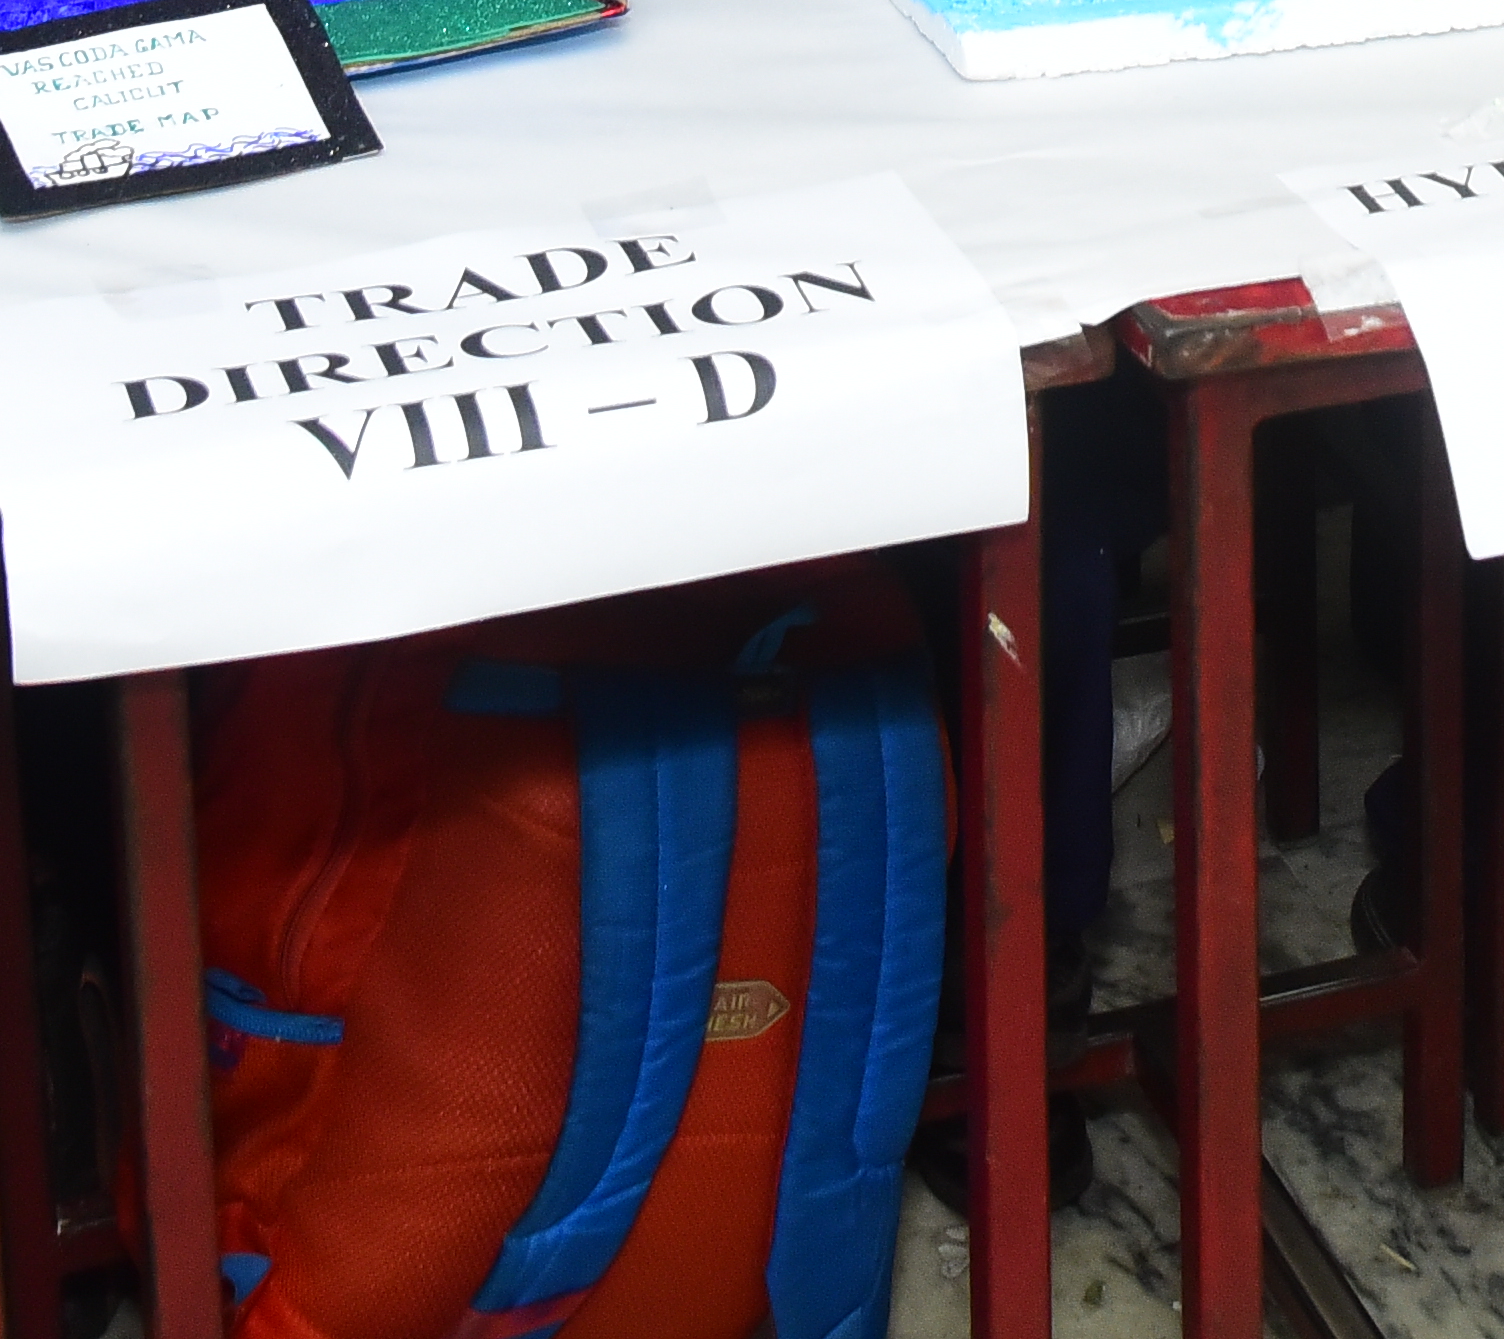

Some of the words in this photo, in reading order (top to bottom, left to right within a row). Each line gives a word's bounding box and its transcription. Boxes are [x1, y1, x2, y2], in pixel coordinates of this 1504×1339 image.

[135, 28, 207, 54] GAMA
[32, 60, 165, 95] REACHED
[74, 80, 184, 111] CALICUT
[52, 119, 144, 145] TRADE
[158, 107, 220, 129] MAP
[245, 233, 696, 333] TRADE
[113, 260, 879, 422] DIRECTION
[289, 380, 559, 480] VIII
[689, 349, 779, 426] D
